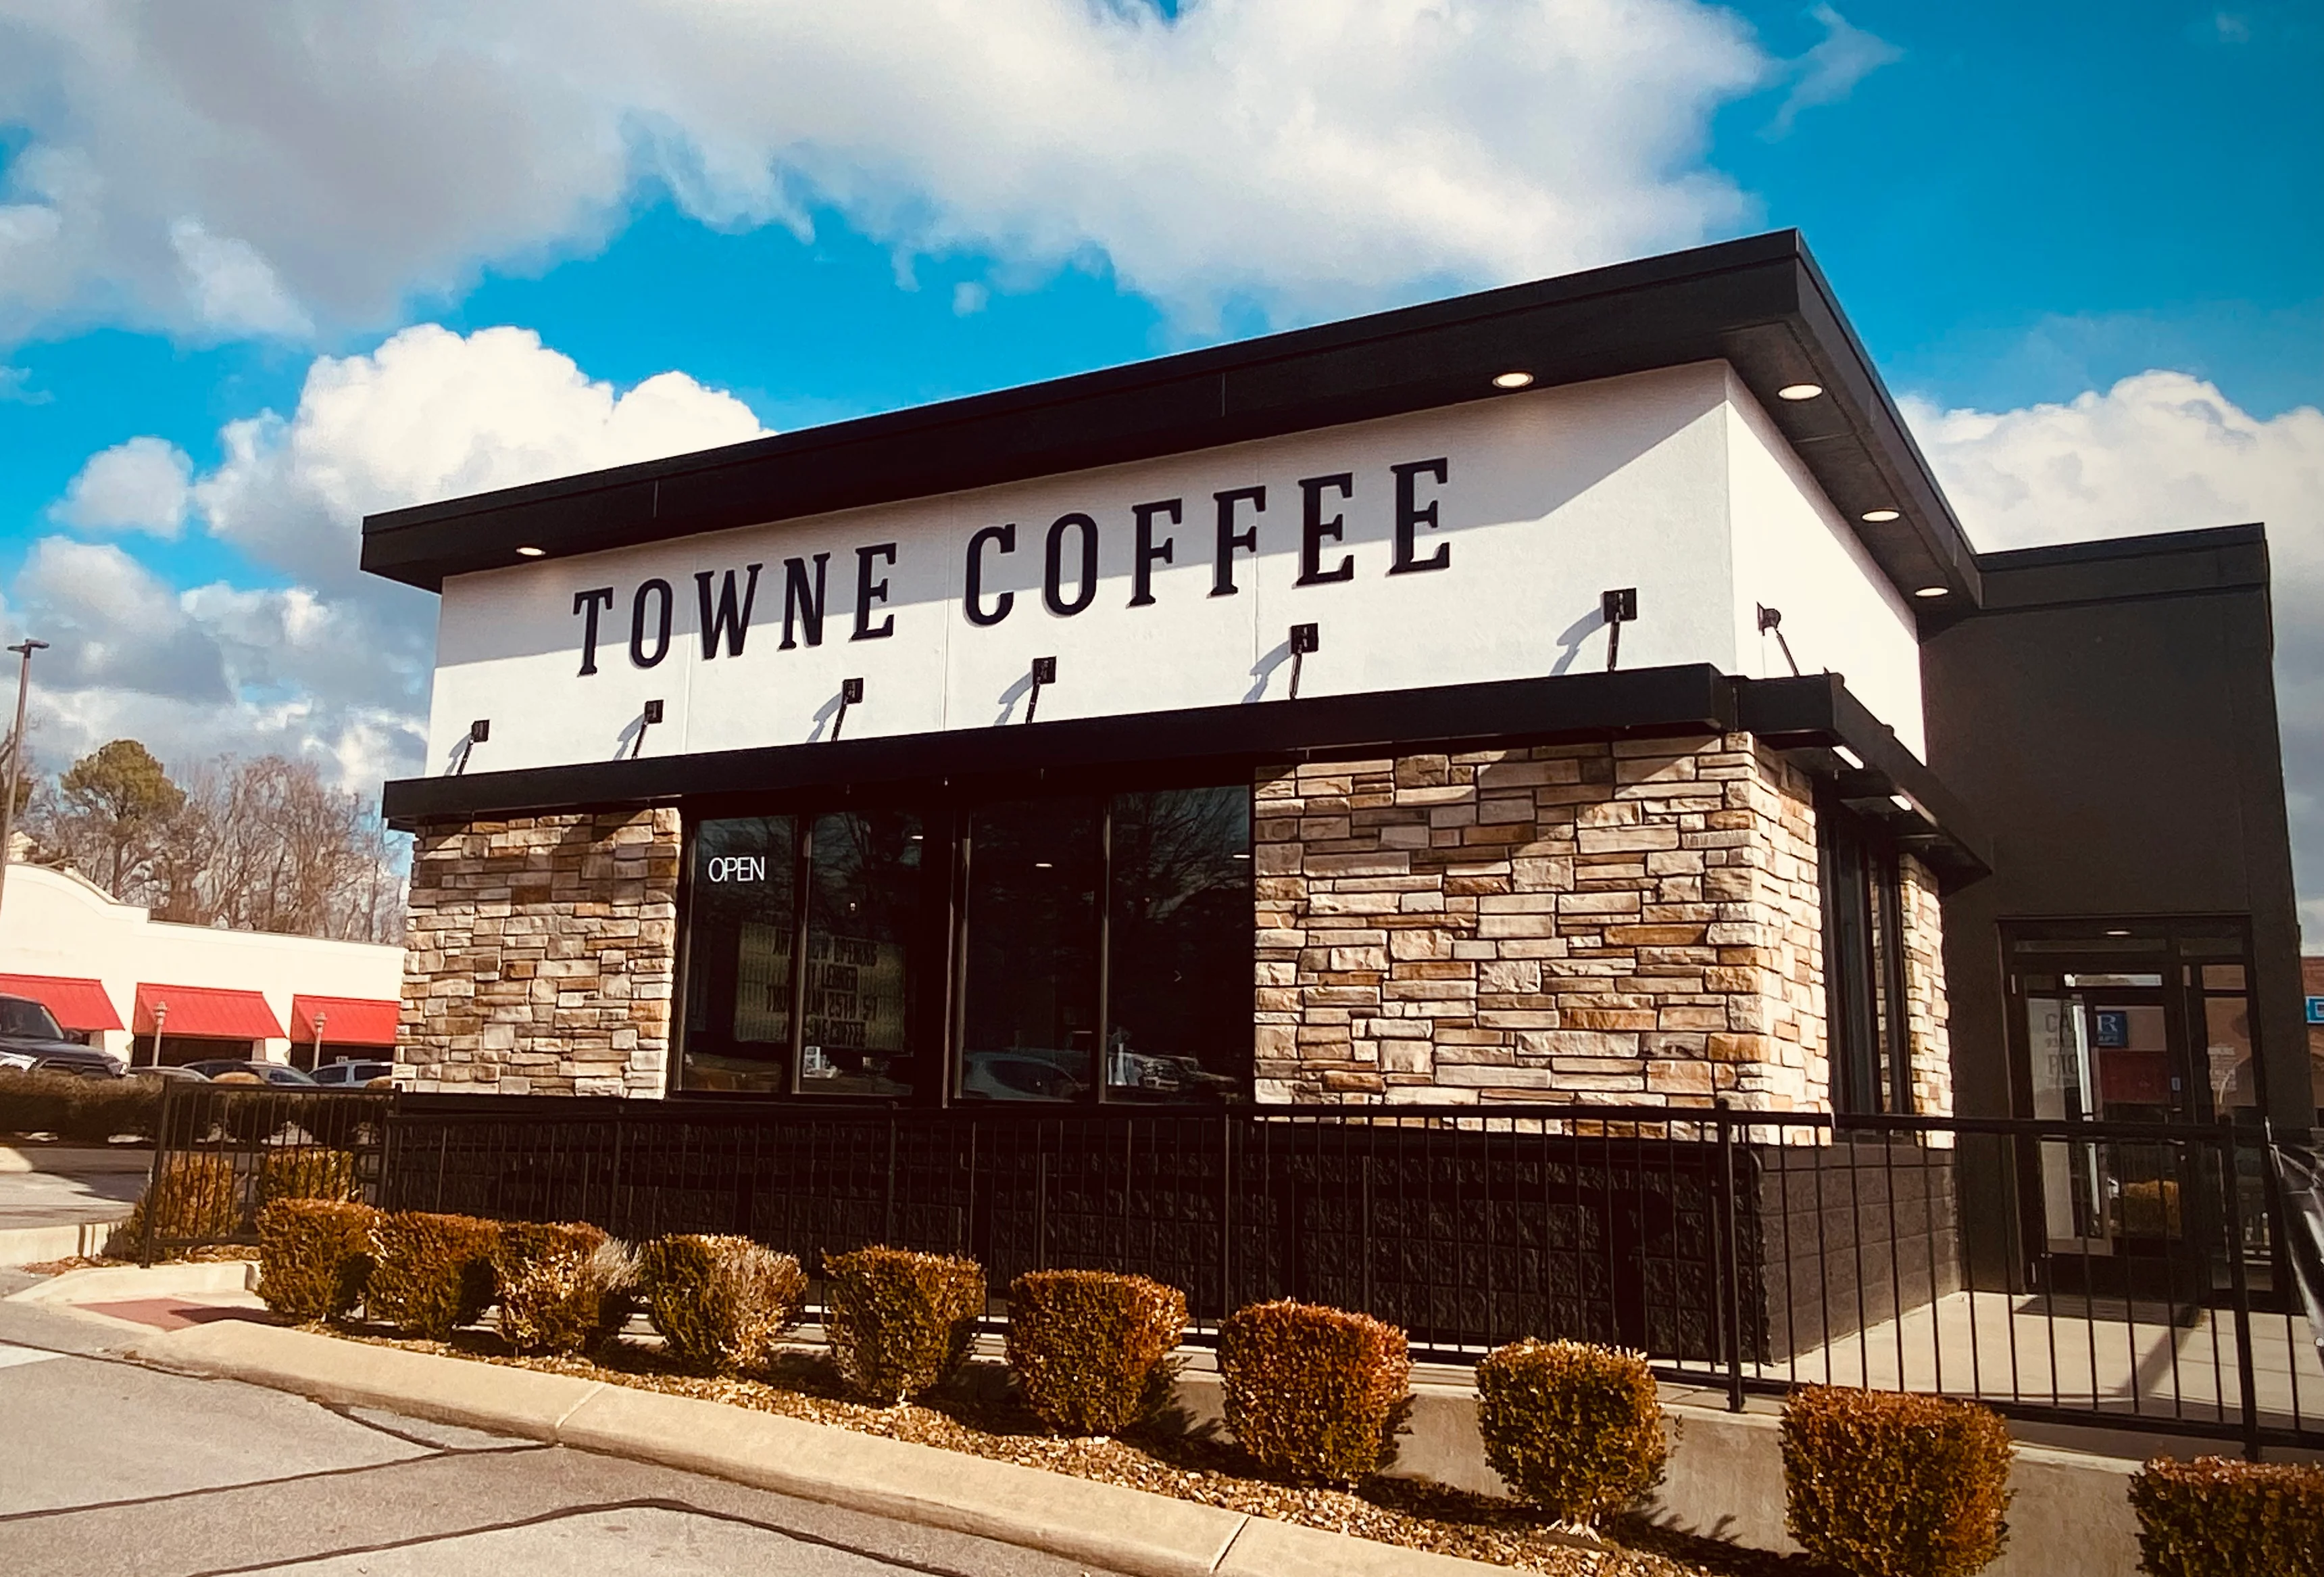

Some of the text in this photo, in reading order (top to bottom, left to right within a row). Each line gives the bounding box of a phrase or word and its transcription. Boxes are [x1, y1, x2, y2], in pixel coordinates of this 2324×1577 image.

[573, 457, 1450, 676] TOWNE COFFEE
[708, 856, 765, 882] OPEN
